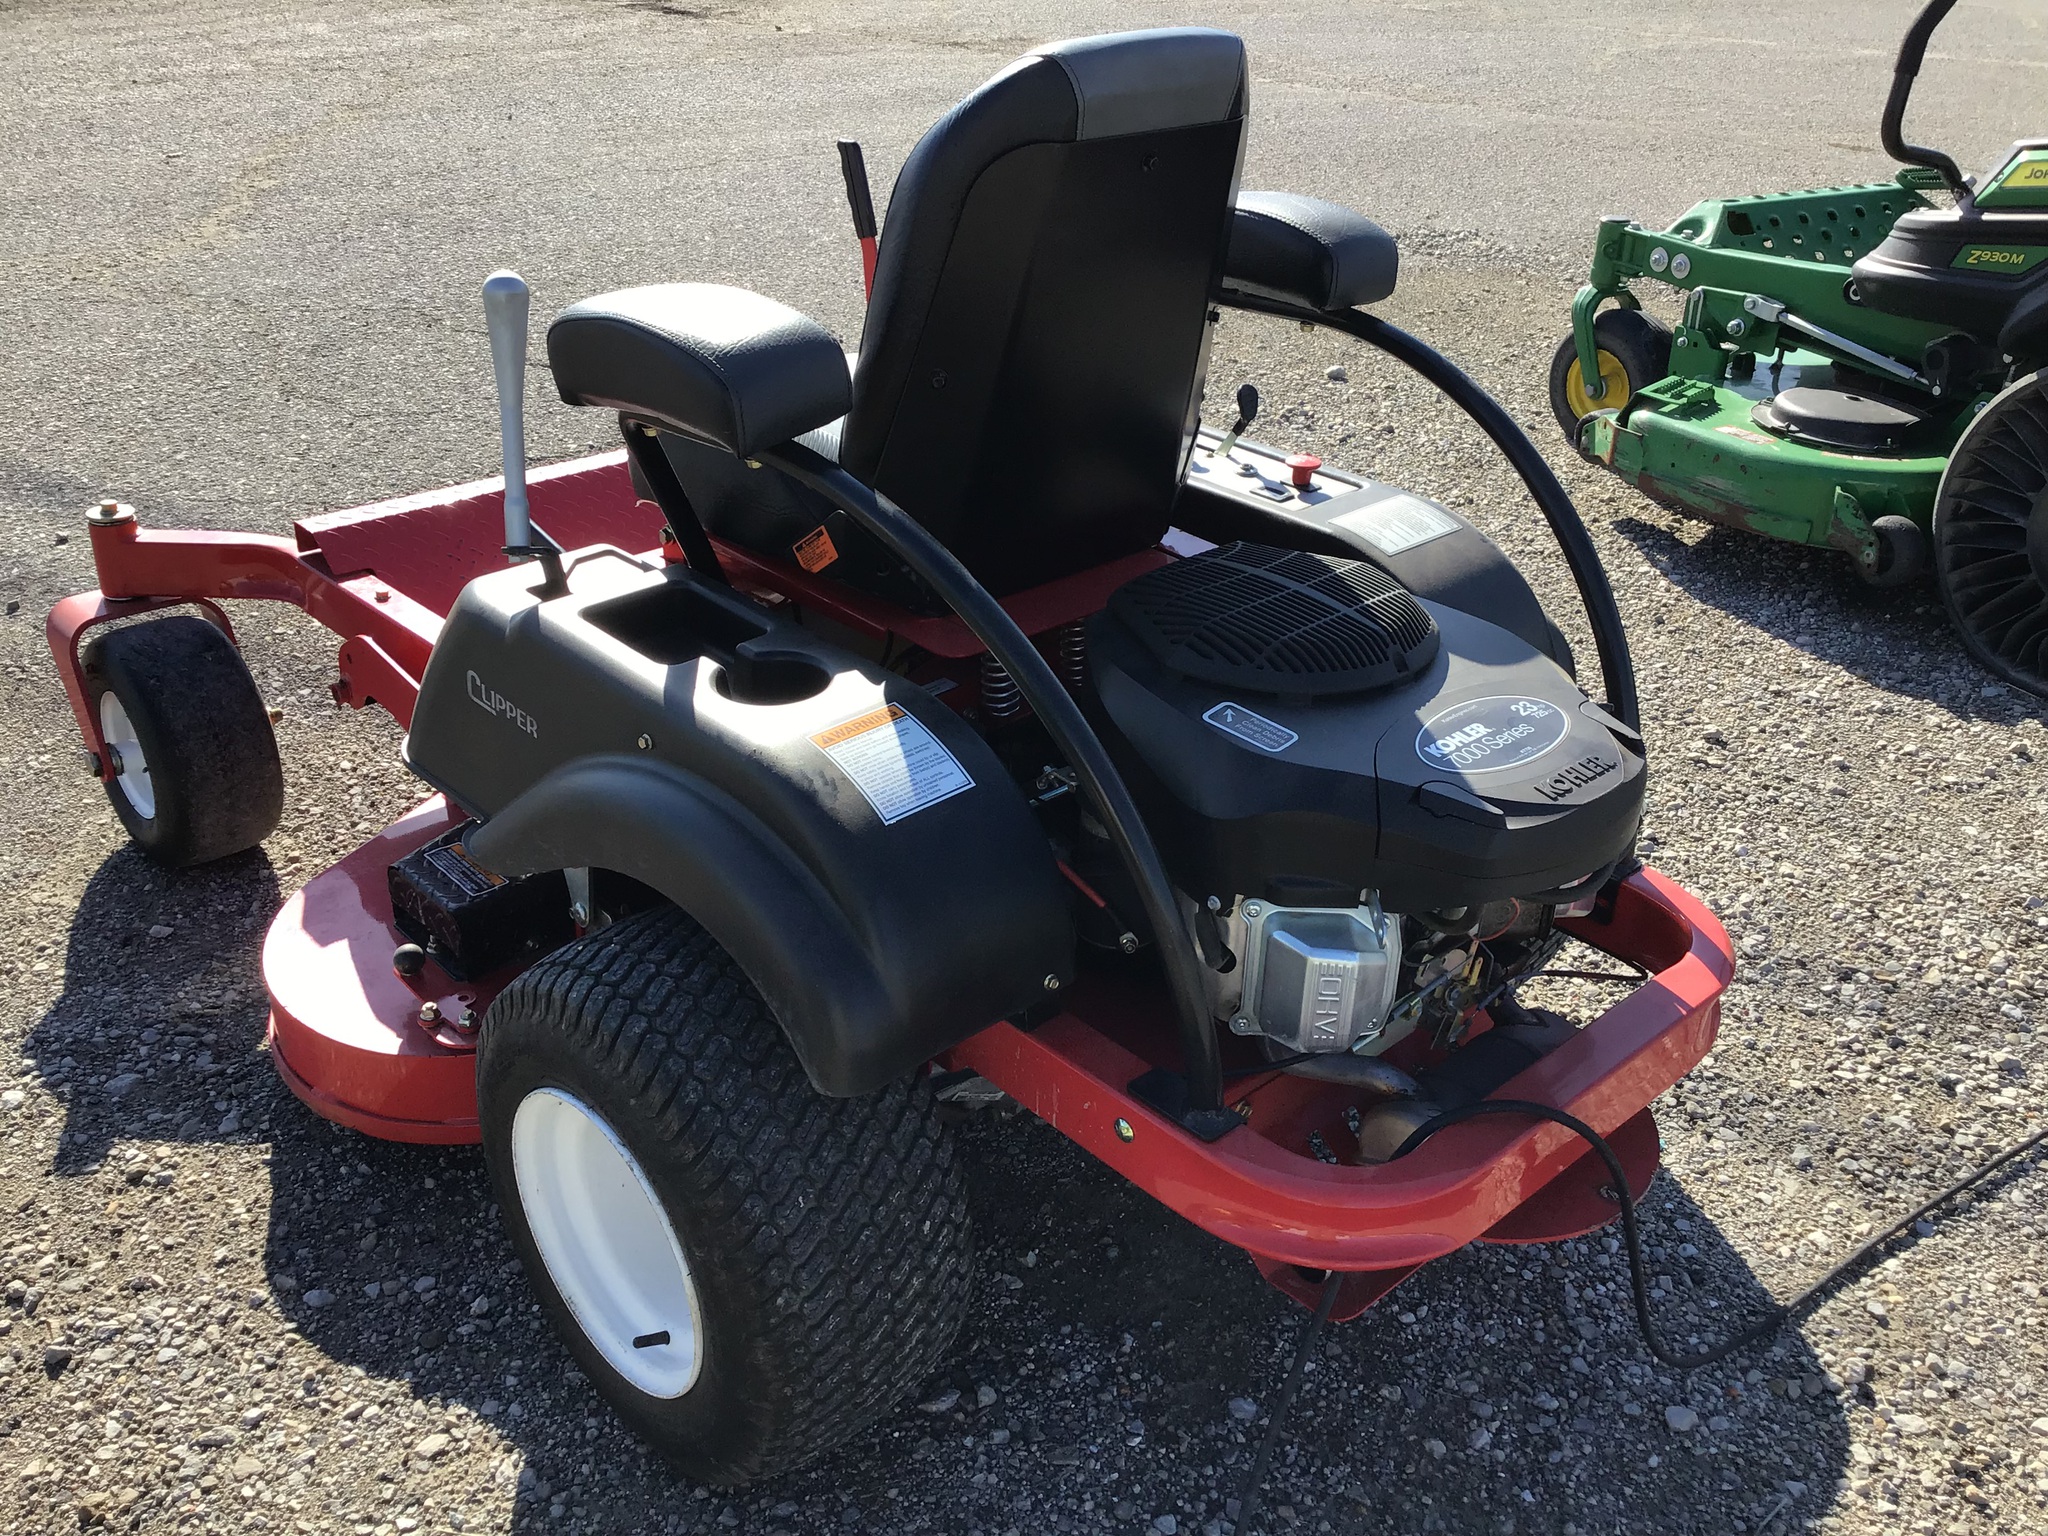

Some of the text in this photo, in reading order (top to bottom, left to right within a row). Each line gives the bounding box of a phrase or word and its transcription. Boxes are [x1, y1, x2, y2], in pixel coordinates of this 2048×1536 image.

[1967, 250, 2025, 264] Z930M
[1510, 701, 1538, 716] 23
[1530, 709, 1549, 719] 725
[830, 708, 899, 737] WARNING
[1235, 723, 1253, 735] From
[1242, 720, 1285, 743] Clean Debris
[1250, 717, 1288, 738] Periodically
[1423, 722, 1493, 758] KOHLER
[1443, 743, 1491, 768] 7000
[1482, 723, 1535, 749] Series
[1533, 755, 1617, 802] KOHLER
[1315, 977, 1341, 1034] OHV
